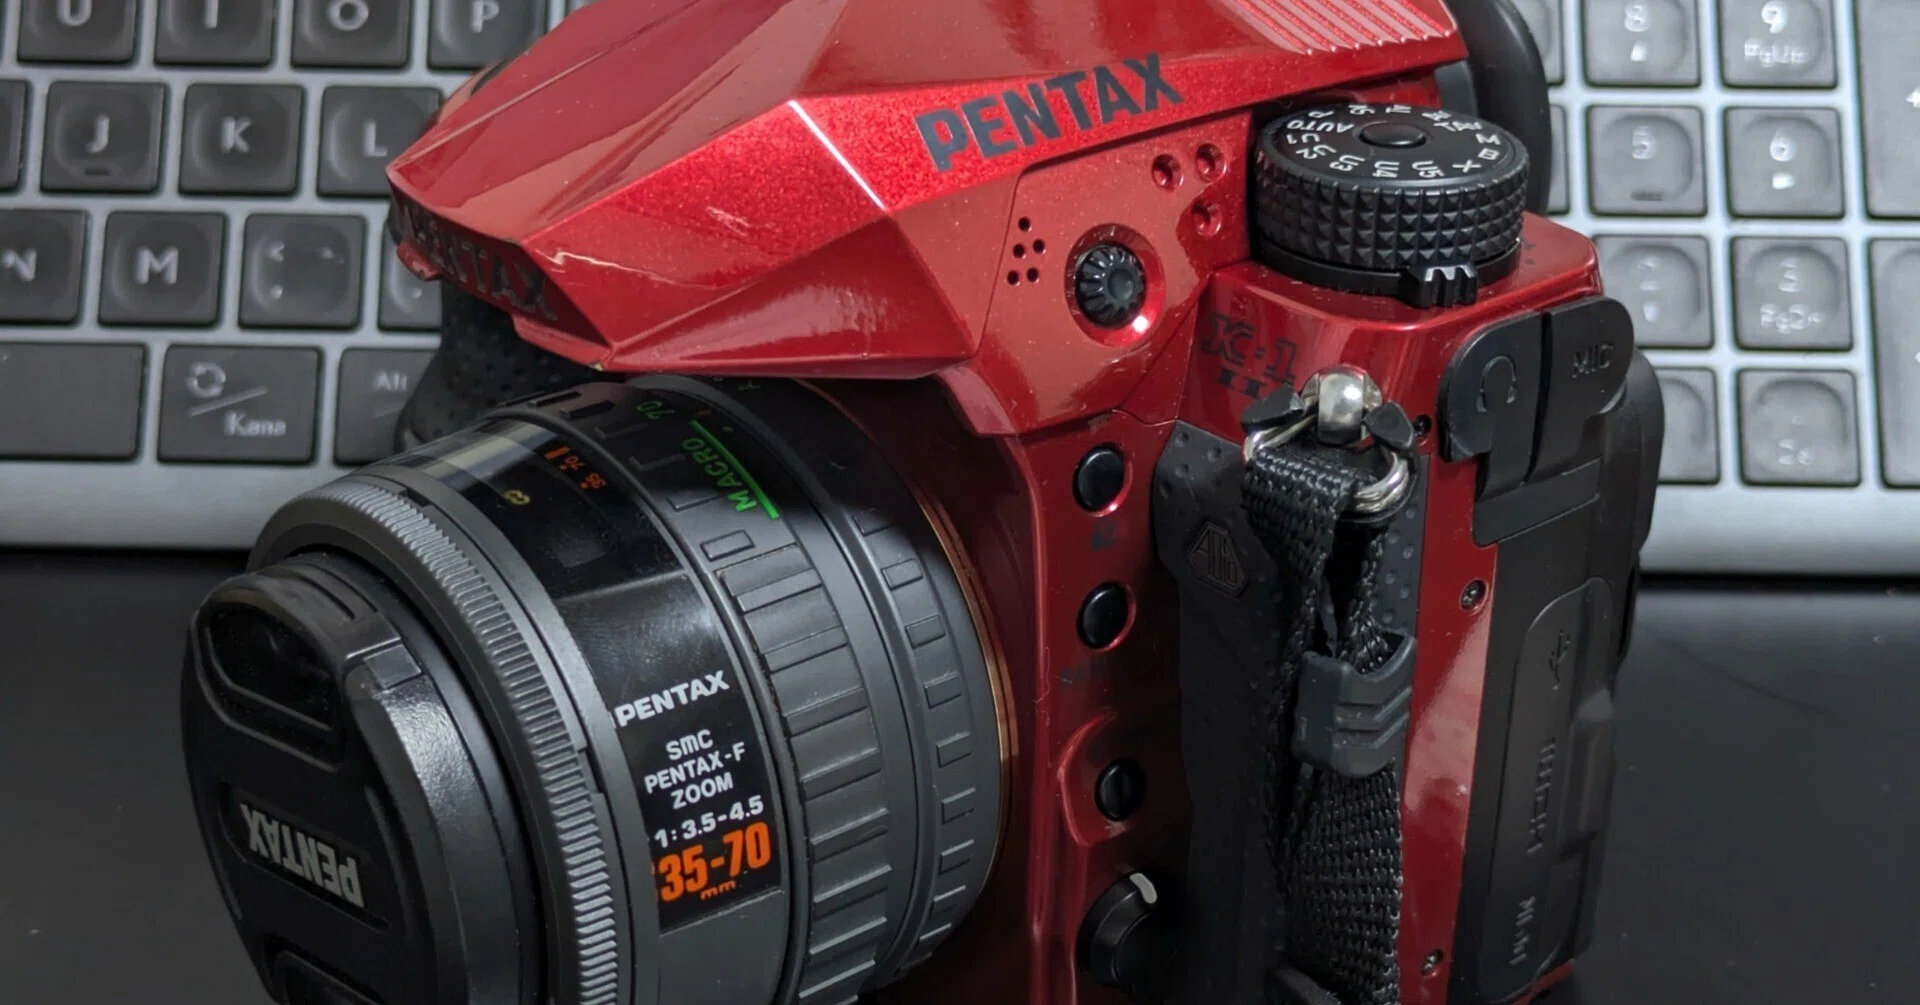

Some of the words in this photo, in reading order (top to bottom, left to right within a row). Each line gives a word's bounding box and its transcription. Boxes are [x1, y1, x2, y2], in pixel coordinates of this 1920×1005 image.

[326, 0, 369, 31] O
[470, 0, 500, 33] P
[1761, 1, 1788, 34] 9
[914, 52, 1185, 173] PENTAX
[1286, 119, 1355, 133] AUTO
[87, 115, 110, 154] J
[221, 117, 252, 154] K
[363, 120, 389, 157] L
[1475, 133, 1501, 145] M
[1769, 130, 1796, 162] 6
[1329, 154, 1366, 172] U3
[1372, 160, 1400, 178] U4
[1411, 160, 1445, 178] U5
[1477, 148, 1500, 160] B
[3, 250, 37, 282] N
[136, 248, 179, 285] M
[1201, 311, 1298, 387] K-1
[1571, 343, 1614, 379] MIC
[225, 412, 287, 437] Kana
[680, 436, 758, 513] MACRO
[613, 669, 731, 728] PENTAX
[643, 741, 746, 795] PENTAX-F
[670, 771, 734, 810] ZOOM
[239, 802, 366, 910] PENTAX
[657, 820, 772, 902] 35-70
[700, 879, 737, 901] mm
